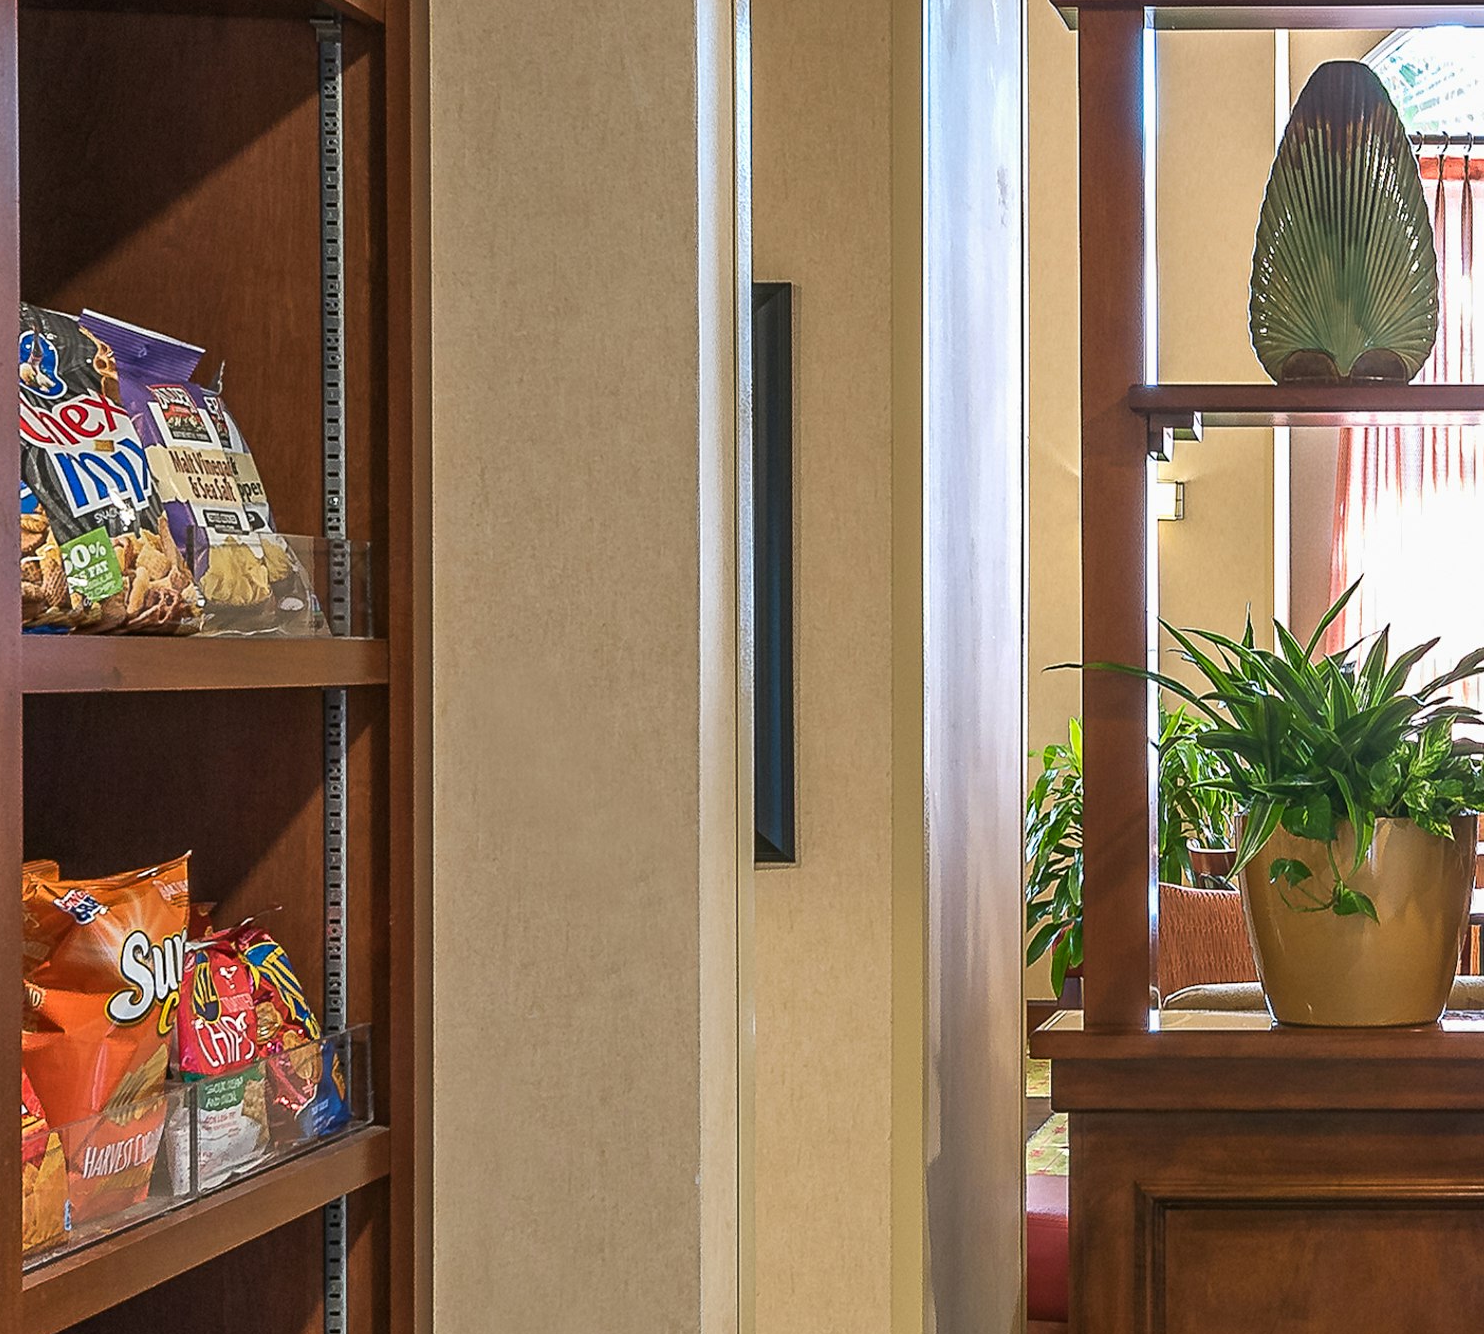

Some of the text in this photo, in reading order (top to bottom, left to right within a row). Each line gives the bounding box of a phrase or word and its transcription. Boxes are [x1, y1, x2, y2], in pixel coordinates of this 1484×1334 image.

[169, 450, 197, 475] Malt
[198, 477, 217, 500] Sea
[214, 478, 238, 503] Salt
[193, 1011, 256, 1068] CHIPS
[82, 1136, 135, 1180] HARVEST
